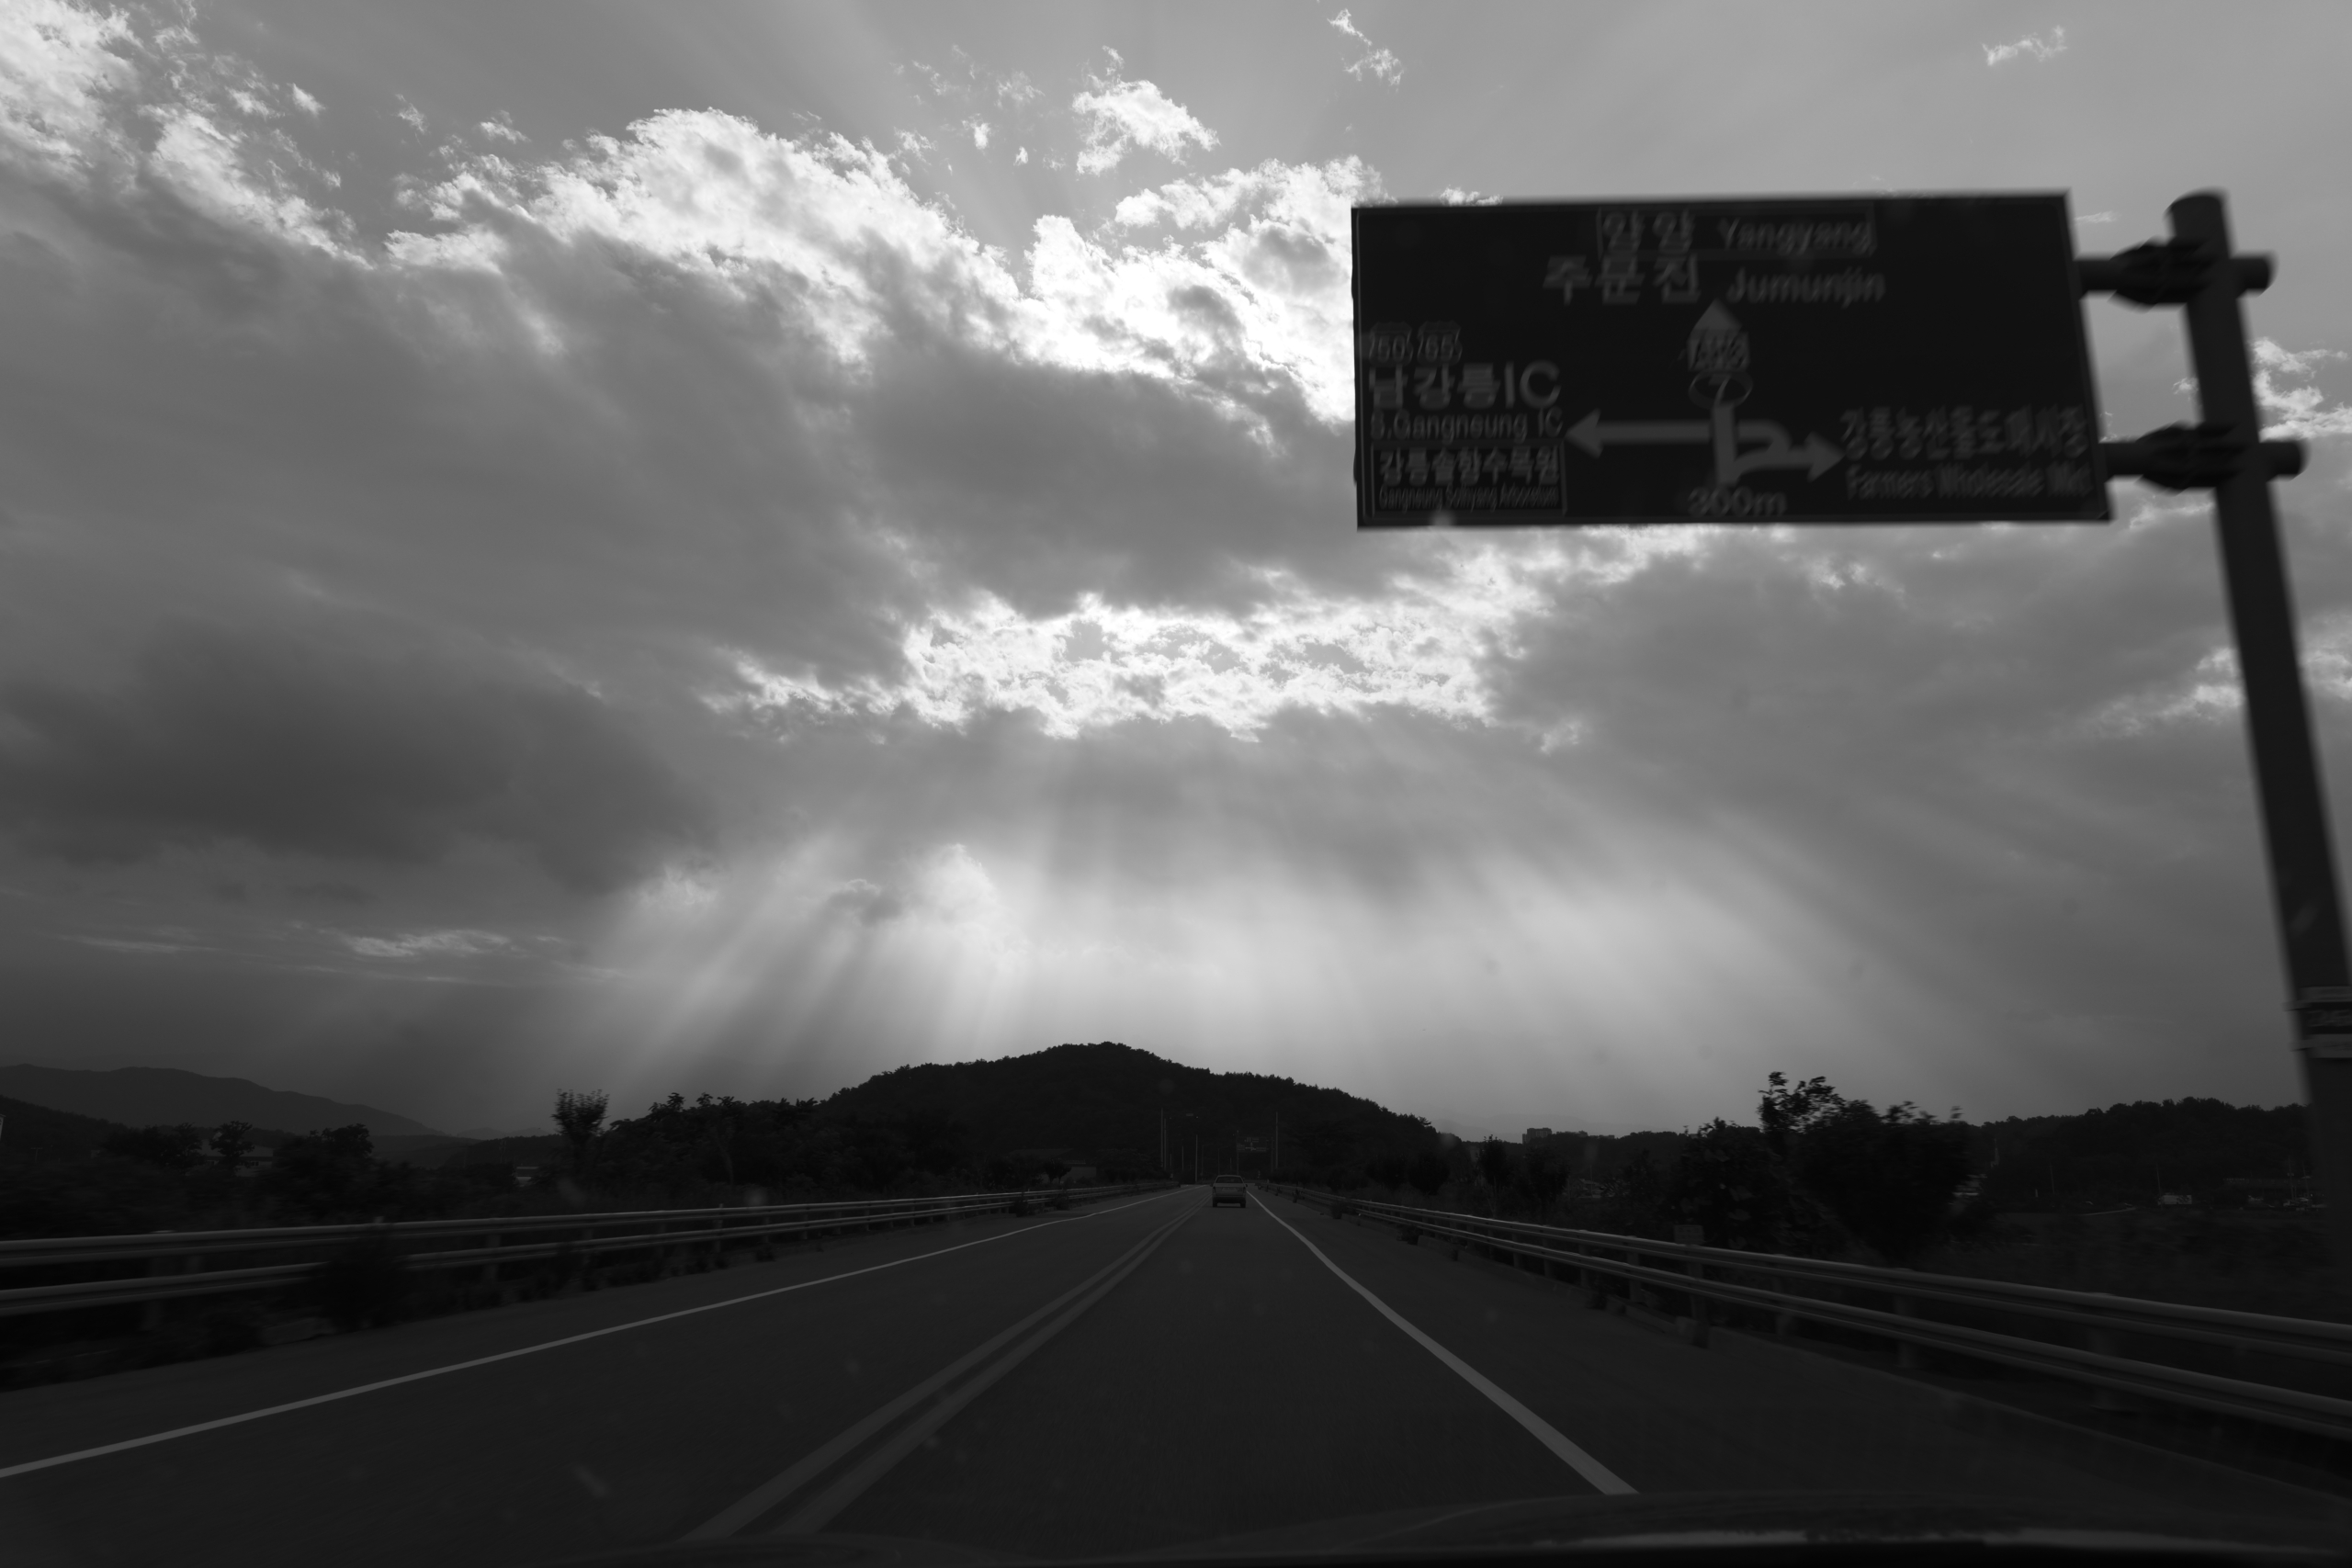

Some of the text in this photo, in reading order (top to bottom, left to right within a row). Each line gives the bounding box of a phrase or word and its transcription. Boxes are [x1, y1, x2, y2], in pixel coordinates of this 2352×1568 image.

[1602, 208, 1872, 256] 양양 Yangyang
[1543, 254, 1886, 309] 주문진 Jumunjin
[1377, 333, 1406, 364] 50
[1425, 333, 1454, 363] 65
[1369, 359, 1562, 411] 남강릉IC
[1537, 406, 1564, 438] IC
[1839, 404, 2090, 460] 강릉농산물도매시장
[1379, 446, 1560, 486] 강릉솔향수목원
[1845, 463, 1935, 500] Farmers
[1934, 461, 2045, 499] Wholesale
[1379, 482, 1559, 514] Gangneung Solhyang Arboretum
[1688, 486, 1787, 518] 300m
